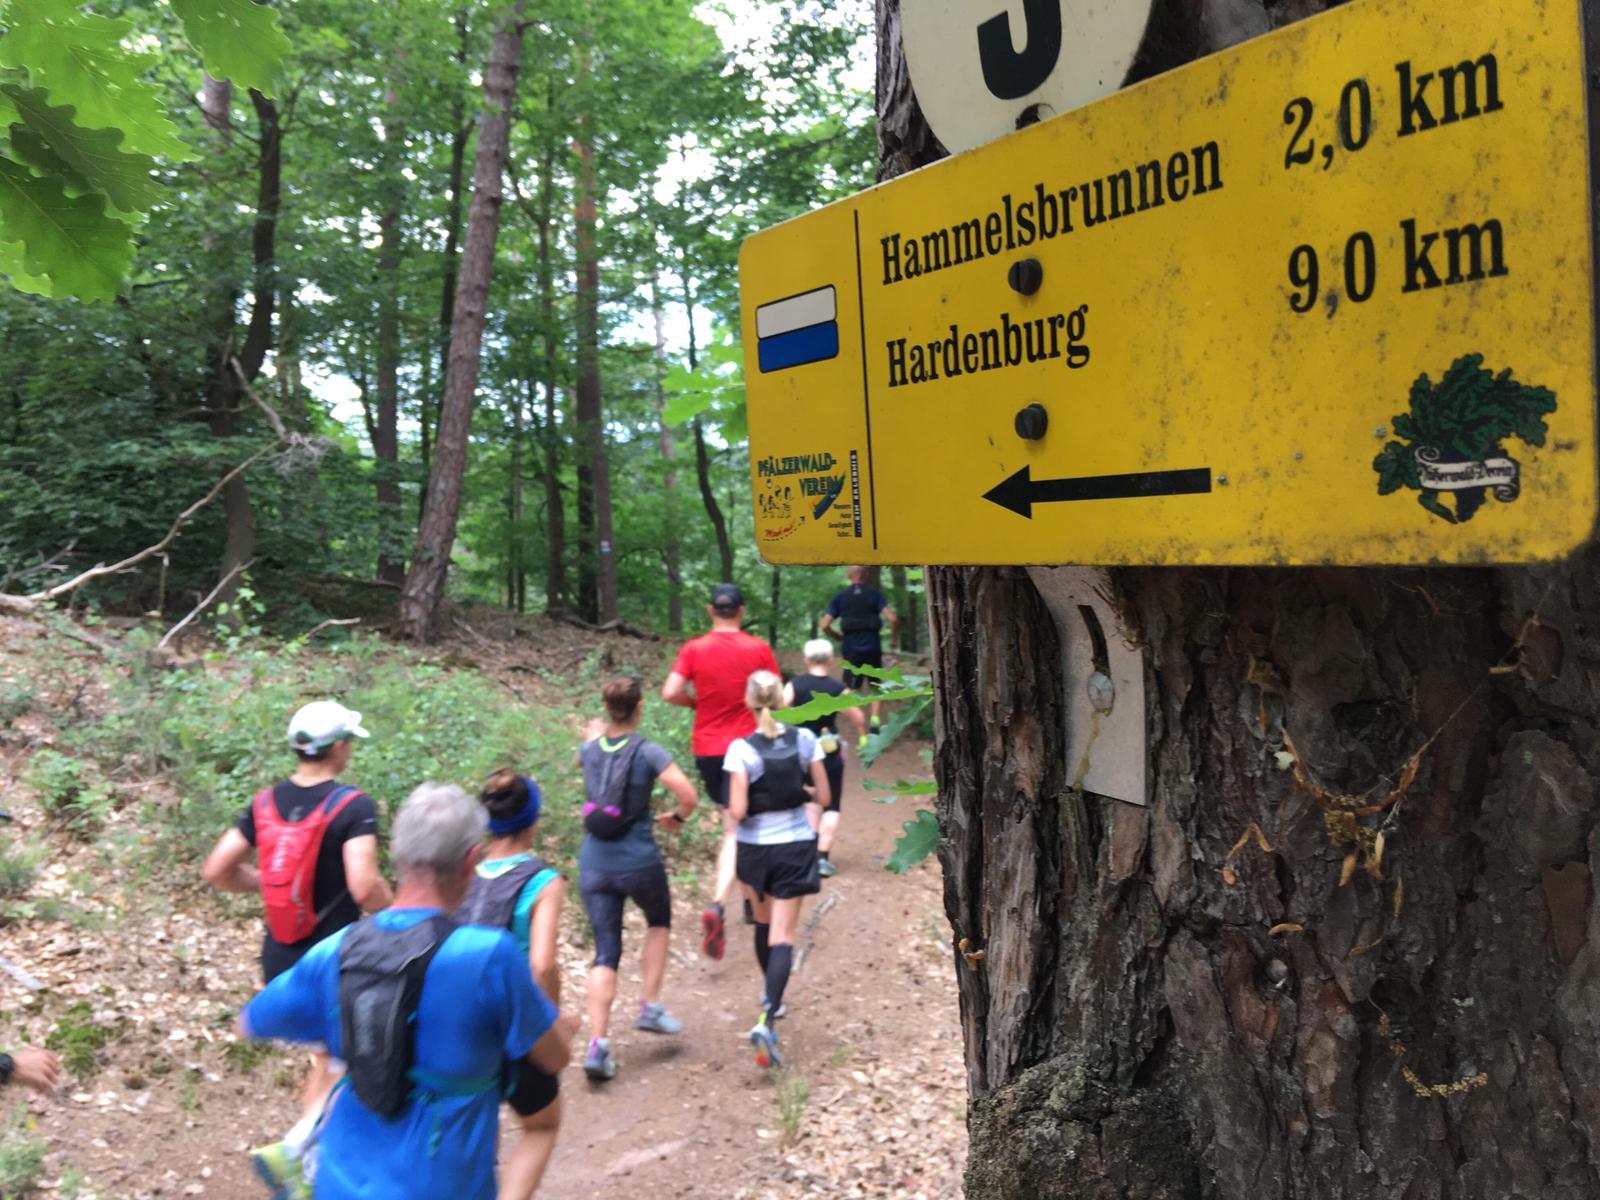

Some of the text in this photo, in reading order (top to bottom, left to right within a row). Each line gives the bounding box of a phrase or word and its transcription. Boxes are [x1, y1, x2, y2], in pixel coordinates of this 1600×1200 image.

[881, 53, 1504, 286] Hammelsbrunnen 2,0 km
[887, 218, 1509, 388] Hardenburg 9,0 km
